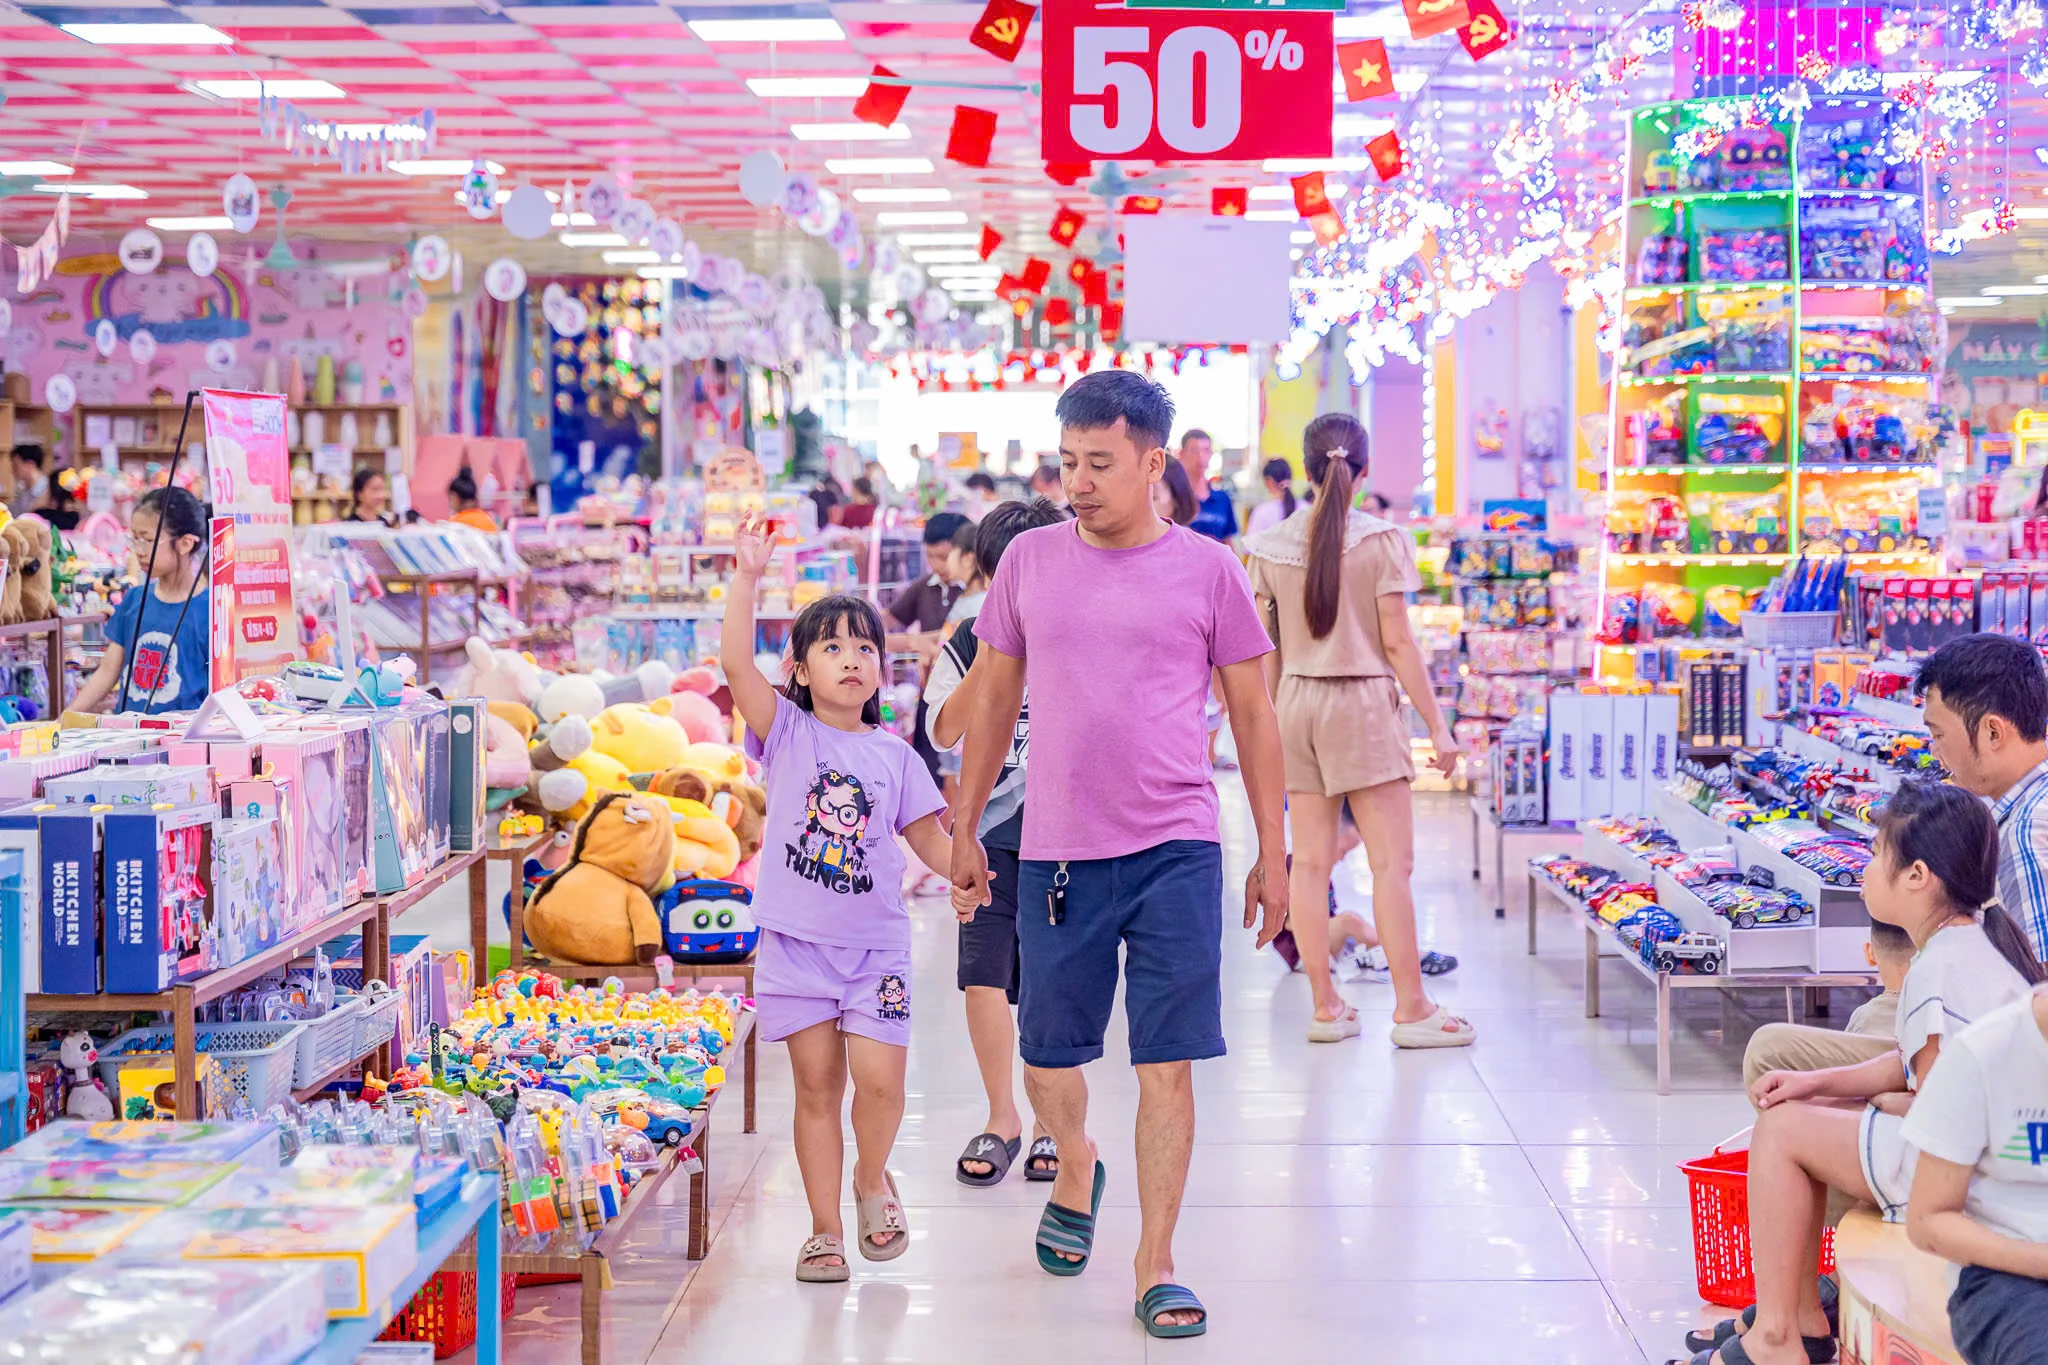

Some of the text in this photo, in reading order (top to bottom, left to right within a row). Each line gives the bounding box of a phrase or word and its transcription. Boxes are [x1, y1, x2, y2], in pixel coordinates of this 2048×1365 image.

[1069, 26, 1304, 154] 50%
[52, 861, 65, 918] WORLD
[66, 868, 80, 946] KITCHEN
[116, 860, 129, 917] WORLD
[129, 867, 143, 945] KITCHEN
